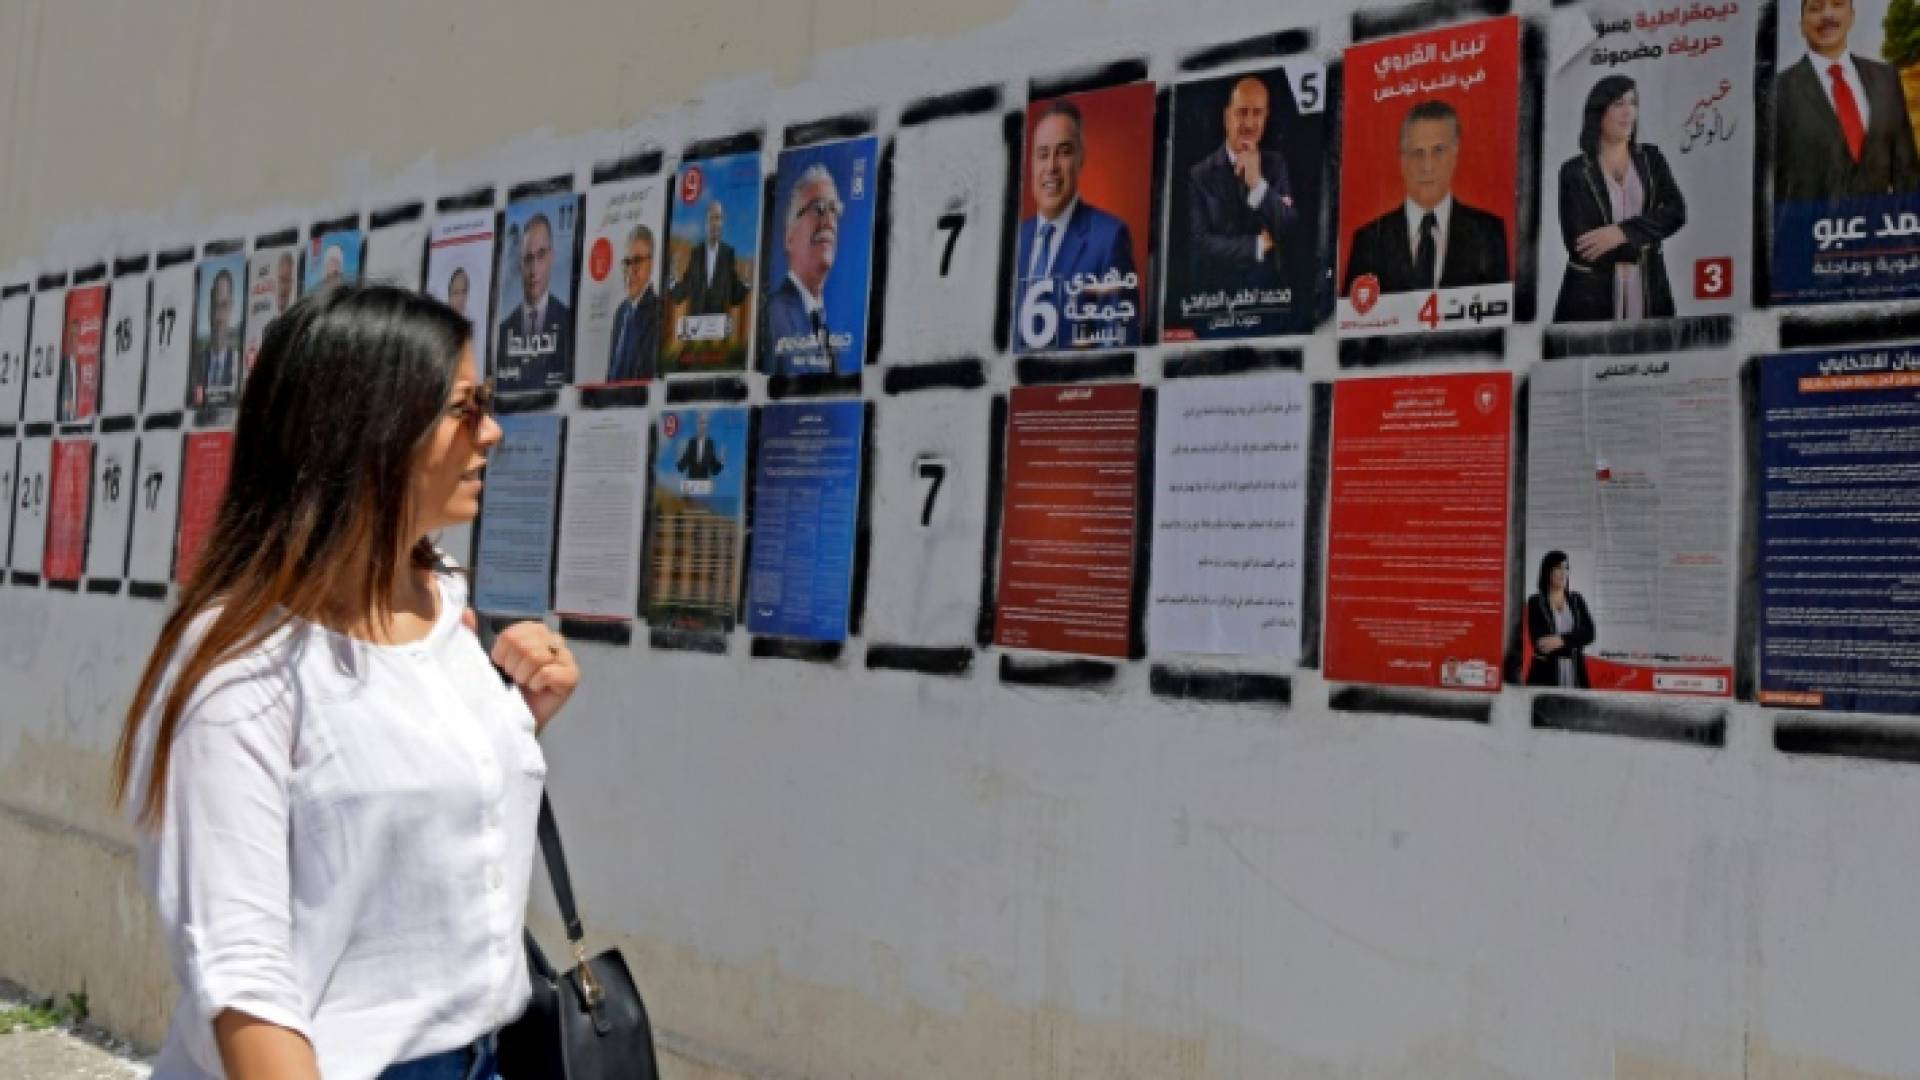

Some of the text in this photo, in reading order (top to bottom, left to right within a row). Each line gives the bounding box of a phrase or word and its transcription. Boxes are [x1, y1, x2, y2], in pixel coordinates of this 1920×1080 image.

[1374, 35, 1486, 80] نبيل القروي
[1299, 72, 1318, 110] 5
[937, 213, 966, 278] 7
[1813, 215, 1867, 250] عبو
[1064, 266, 1138, 297] مهدي
[1703, 264, 1723, 292] 3
[156, 308, 176, 347] 17
[1020, 279, 1059, 349] 6
[1064, 296, 1135, 323] جمعة
[1417, 291, 1440, 329] 4
[919, 463, 946, 526] 7
